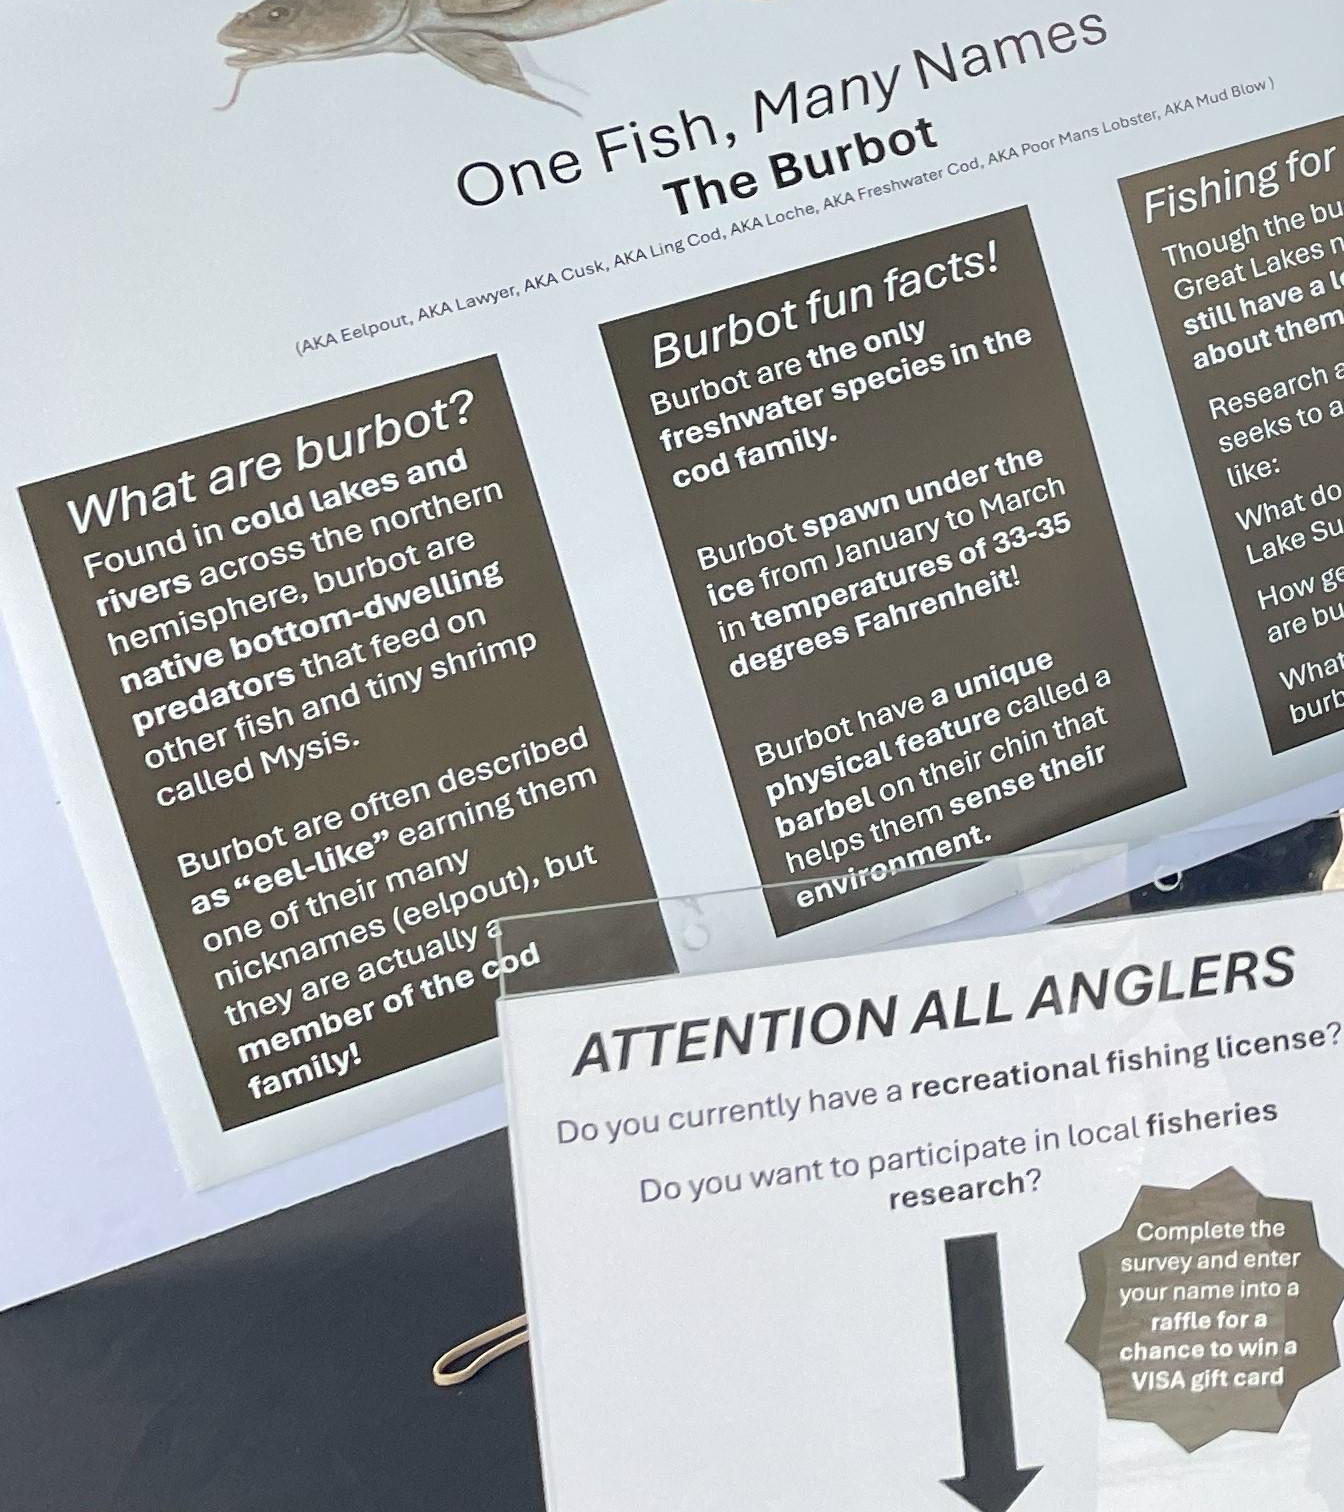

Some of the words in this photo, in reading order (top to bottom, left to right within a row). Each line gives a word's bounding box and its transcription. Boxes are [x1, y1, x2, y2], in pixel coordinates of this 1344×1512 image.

[457, 150, 583, 207] One
[595, 108, 737, 173] Fish,
[754, 64, 901, 134] Many
[912, 13, 1108, 90] Names
[661, 171, 759, 216] The
[767, 117, 939, 190] Burbot
[295, 332, 340, 358] (AKA
[340, 314, 415, 344] Eelpout,
[418, 301, 454, 322] AKA
[455, 285, 521, 312] Lawyer,
[524, 272, 559, 293] AKA
[560, 259, 610, 282] Cusk,
[613, 248, 649, 268] AKA
[649, 238, 686, 260] Ling
[686, 226, 728, 248] Cod,
[730, 216, 764, 236] AKA
[765, 204, 820, 227] Loche,
[823, 191, 856, 211] AKA
[857, 168, 944, 201] Freshwater
[946, 156, 985, 176] Cod,
[988, 146, 1020, 166] AKA
[1021, 138, 1056, 156] Poor
[1058, 126, 1100, 146] Mans
[1102, 109, 1161, 134] Lobster,
[1164, 98, 1195, 117] AKA
[1196, 87, 1229, 108] Mud
[1230, 80, 1267, 99] Blow
[1143, 160, 1280, 225] Fishing
[1285, 145, 1337, 183] for
[652, 299, 799, 369] Burbot
[804, 282, 874, 325] fun
[881, 239, 1000, 303] facts!
[66, 470, 198, 535] What
[207, 452, 283, 496] are
[295, 388, 475, 472] burbot?
[571, 995, 899, 1078] ATTENTION
[911, 981, 1013, 1035] ALL
[1025, 945, 1296, 1020] ANGLERS
[557, 1119, 599, 1145] Do
[606, 1113, 660, 1146] you
[668, 1092, 801, 1131] currently
[808, 1085, 878, 1113] have
[886, 1083, 903, 1103] a
[911, 1052, 1101, 1100] recreational
[1105, 1039, 1210, 1074] fishing
[1215, 1021, 1342, 1061] license?
[1131, 1368, 1186, 1392] VISA
[1190, 1368, 1229, 1393] gift
[1233, 1366, 1284, 1387] card
